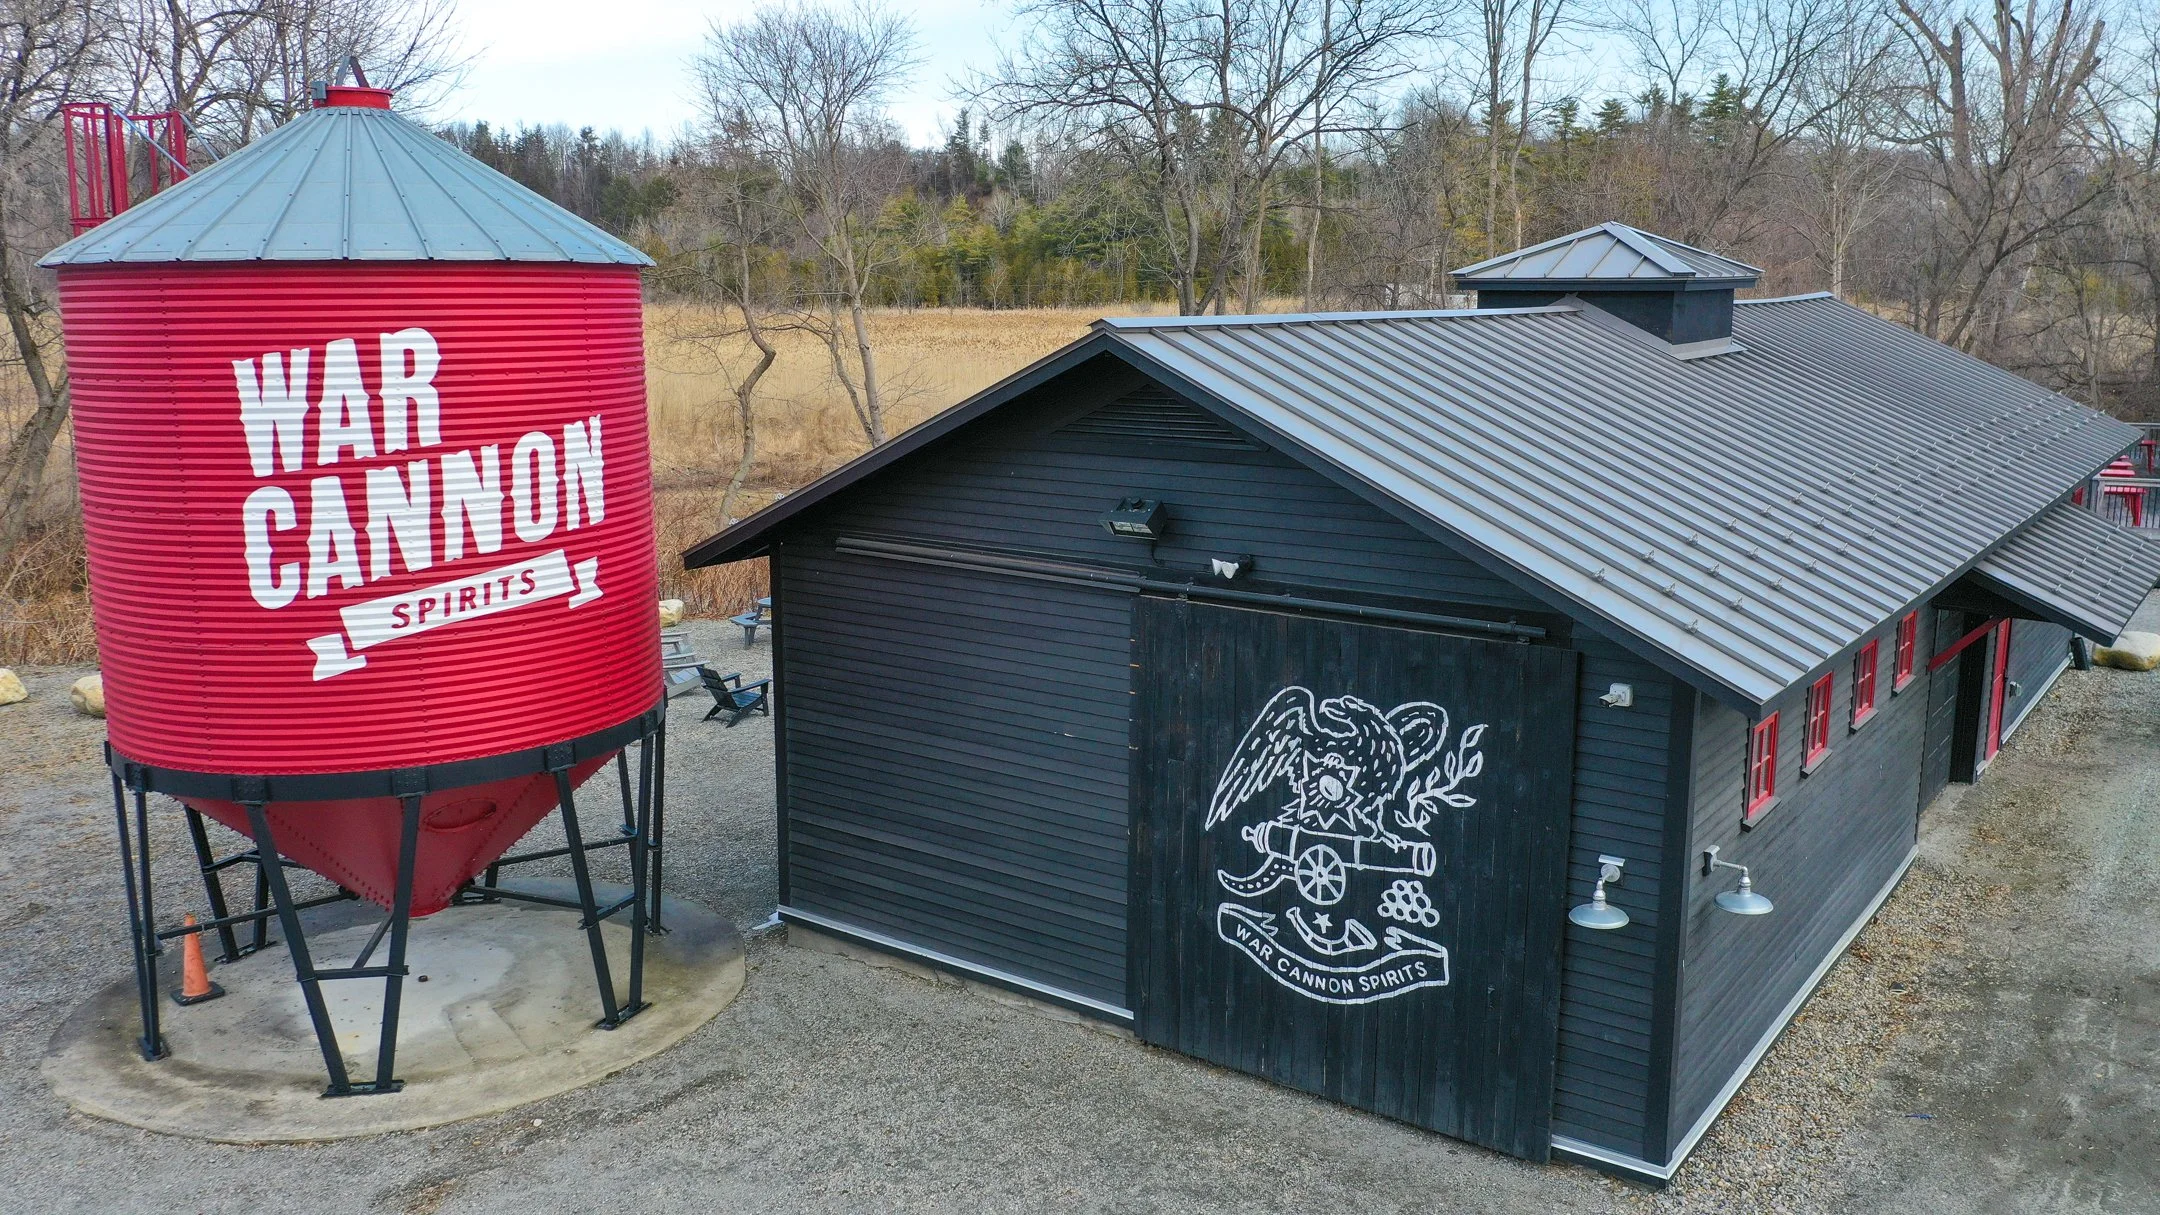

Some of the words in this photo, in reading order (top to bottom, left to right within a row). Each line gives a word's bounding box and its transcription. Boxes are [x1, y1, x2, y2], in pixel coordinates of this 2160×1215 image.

[232, 327, 442, 477] WAR
[242, 414, 605, 609] CANNON
[391, 568, 537, 630] SPIRITS
[1235, 923, 1273, 961] WAR
[1277, 957, 1354, 993] CANNON
[1358, 961, 1428, 992] SPIRITS
